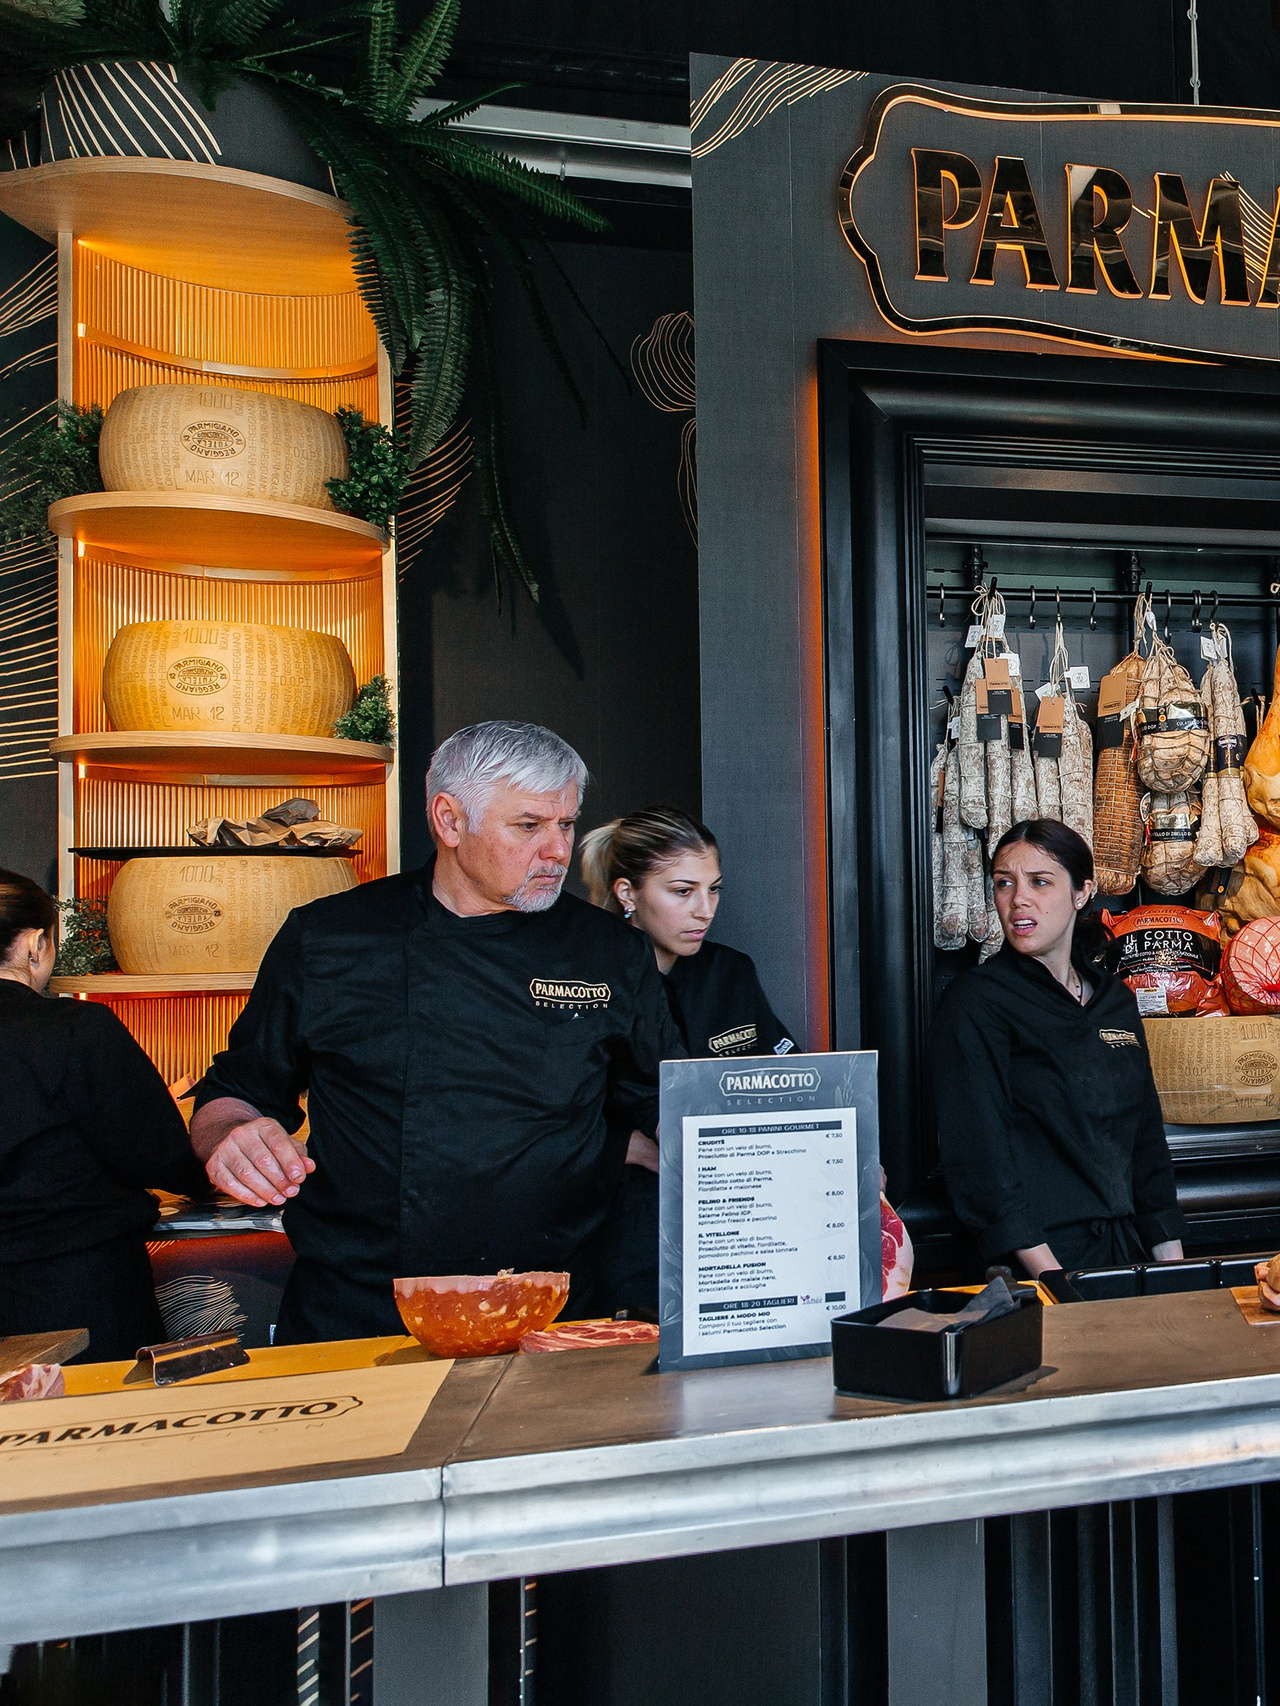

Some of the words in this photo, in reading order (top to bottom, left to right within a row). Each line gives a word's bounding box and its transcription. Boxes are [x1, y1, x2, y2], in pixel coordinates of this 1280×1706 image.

[188, 423, 239, 437] PARMIGIANO
[190, 445, 236, 457] REGGIANO
[186, 469, 215, 484] MAR
[225, 472, 239, 486] 12
[182, 628, 218, 644] 1000
[174, 660, 223, 672] PARMIGIANO
[176, 682, 220, 693] REGGIANO
[172, 707, 201, 720] MAR
[210, 706, 224, 720] 12
[180, 866, 213, 882] 1000
[168, 897, 217, 909] PARMIGIANO
[171, 920, 215, 931] REGGIANO
[1144, 931, 1192, 940] COTTO
[205, 944, 219, 957] 12
[1145, 941, 1193, 951] PARMA
[535, 983, 606, 998] PARMACOTTO
[535, 1001, 608, 1009] SELECTION
[726, 1073, 814, 1090] PARMACOTTO
[727, 1096, 815, 1105] SELECTION
